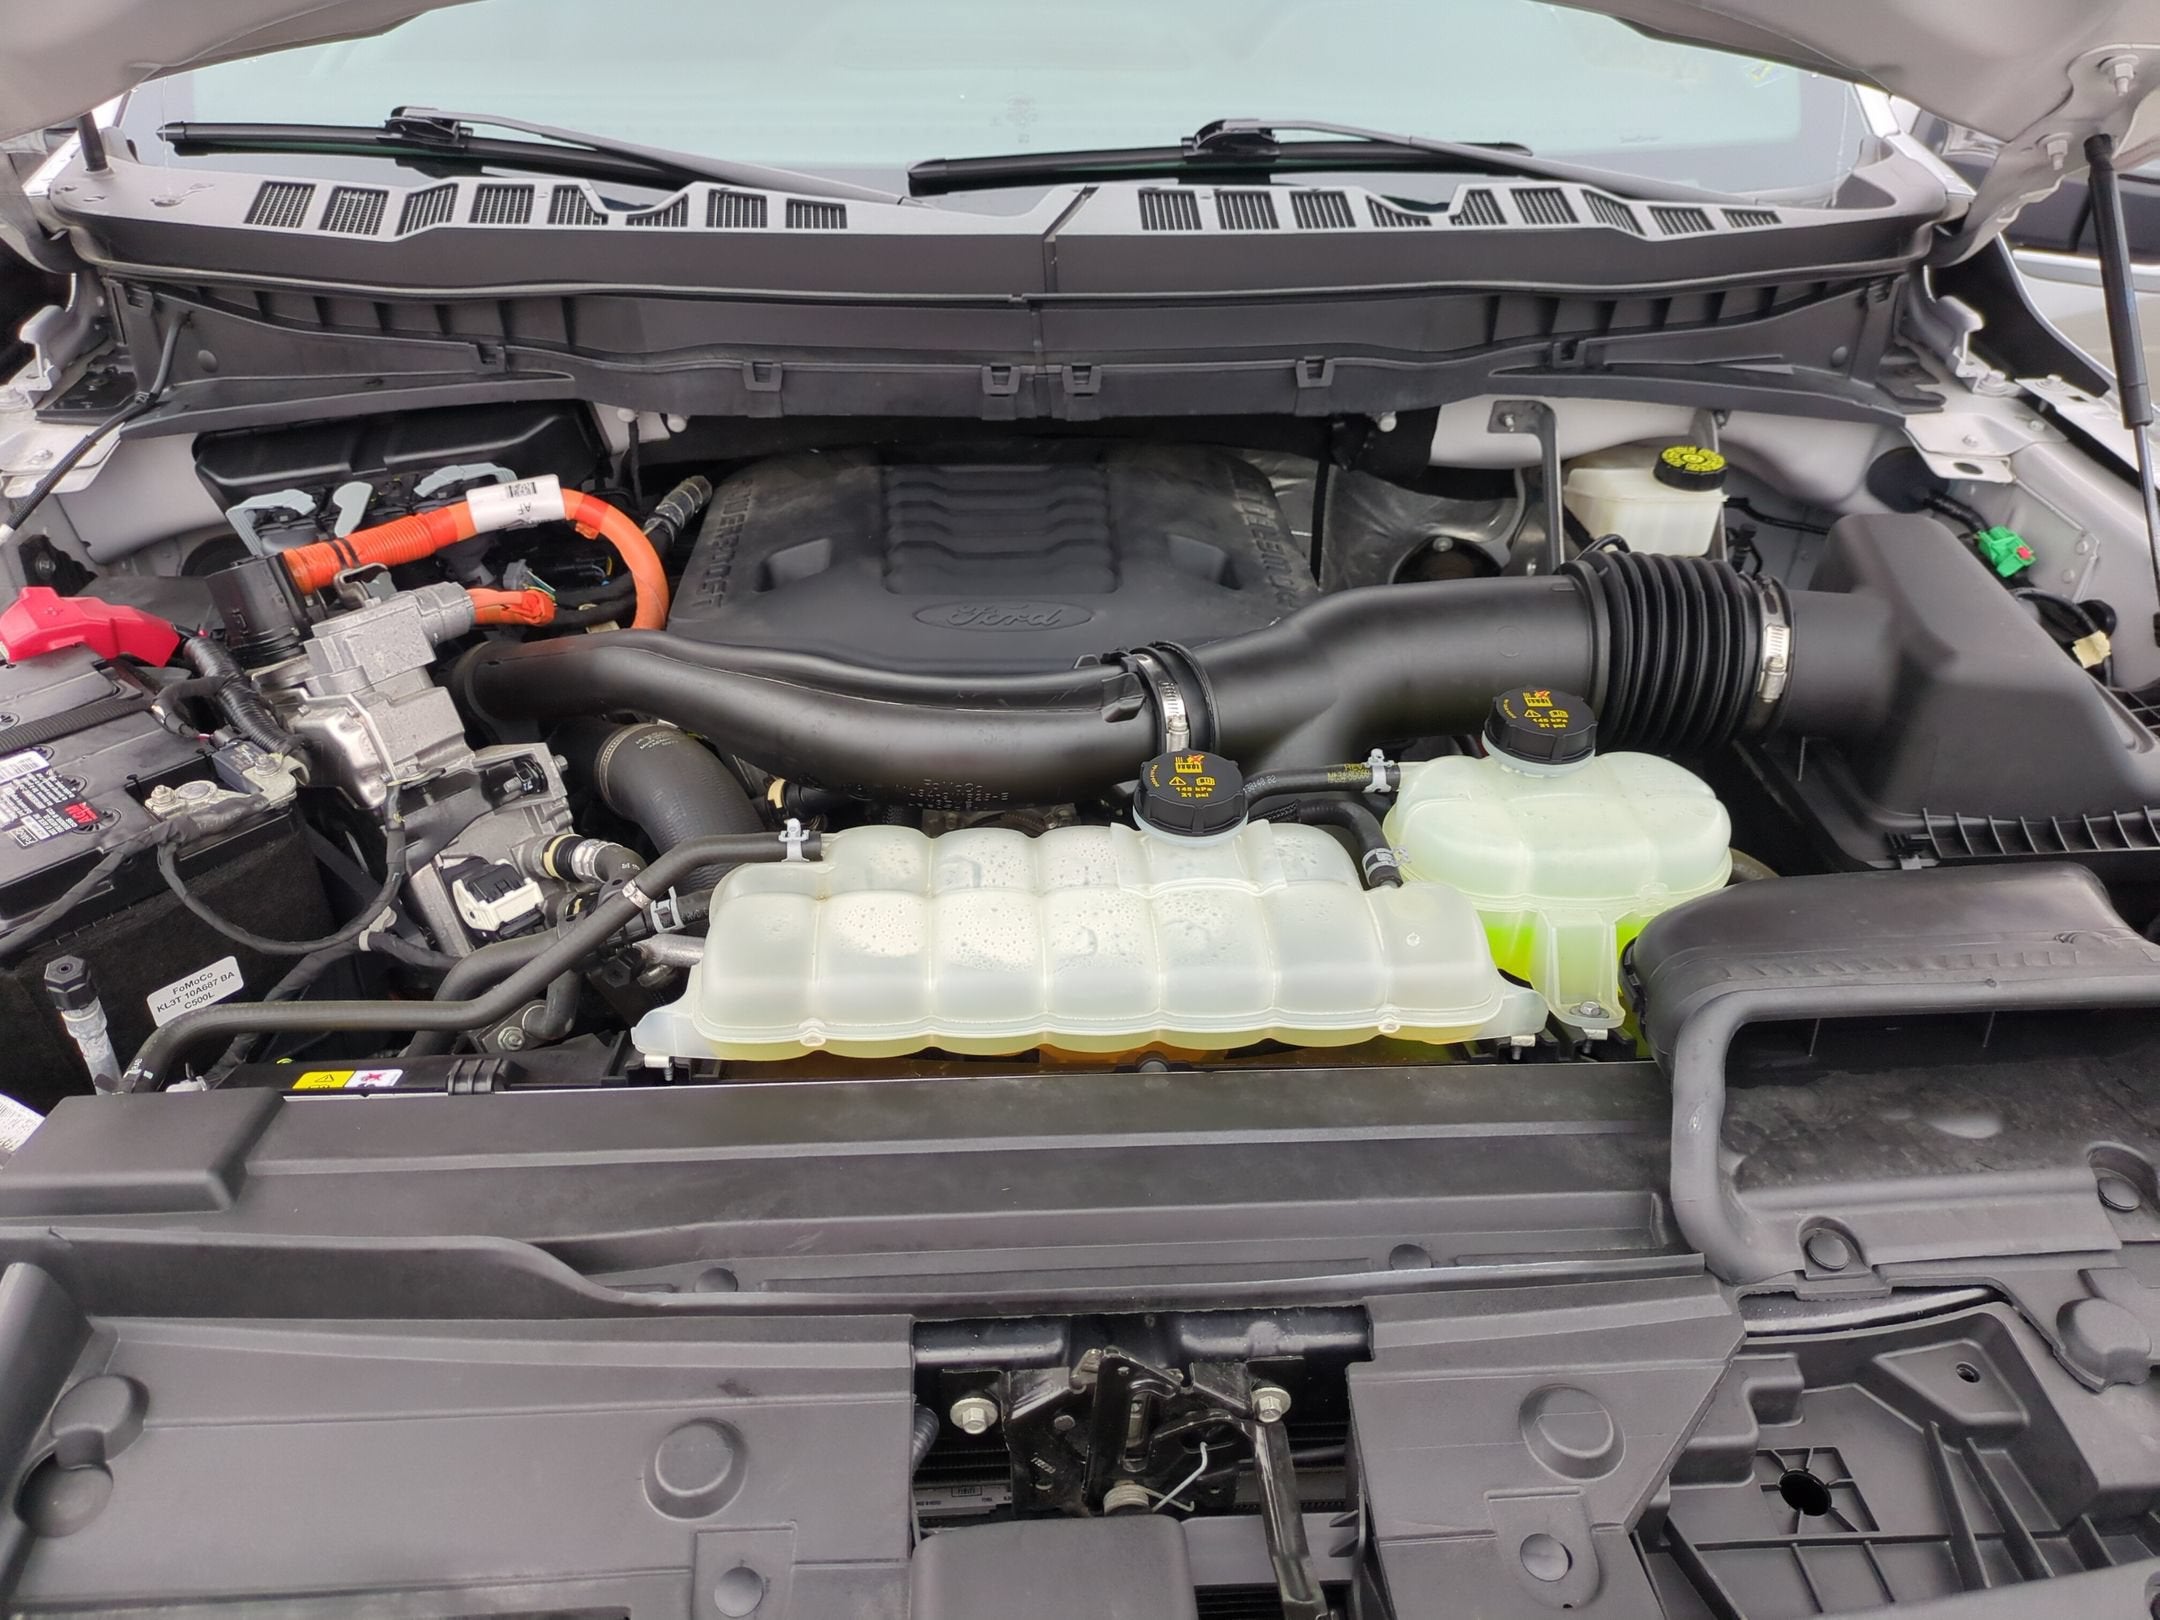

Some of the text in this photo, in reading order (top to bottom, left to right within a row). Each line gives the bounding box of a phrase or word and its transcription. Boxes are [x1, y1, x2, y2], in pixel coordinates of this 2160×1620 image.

[945, 604, 1063, 626] Ford
[156, 971, 235, 1013] KL3T 10A687 BA
[172, 972, 213, 995] FoMoCo
[184, 991, 215, 1010] C500L
